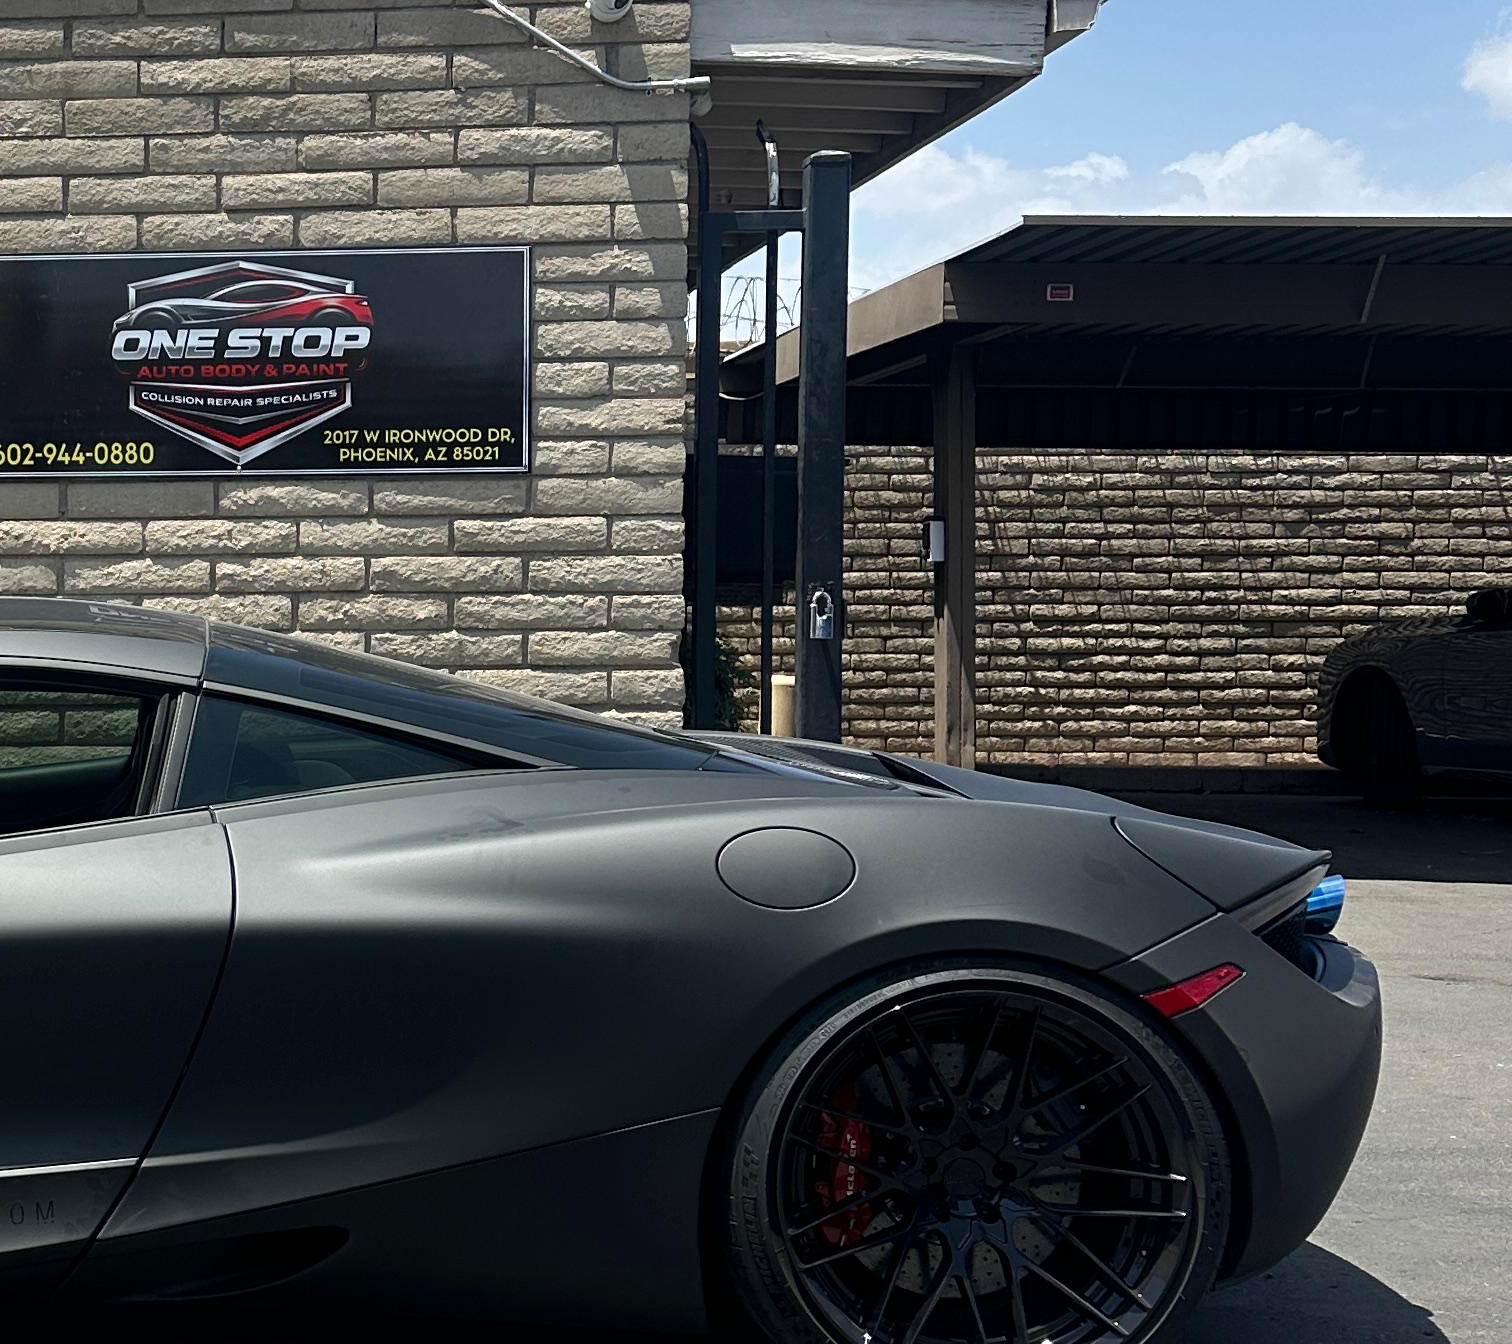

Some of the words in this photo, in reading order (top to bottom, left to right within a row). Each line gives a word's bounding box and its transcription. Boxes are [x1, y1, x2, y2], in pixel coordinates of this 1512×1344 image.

[111, 327, 220, 361] ONE
[224, 326, 371, 359] STOP
[137, 364, 195, 379] AUTO
[201, 363, 260, 378] BODY
[264, 363, 279, 377] &
[282, 362, 349, 376] PAINT
[141, 391, 204, 406] COLLISION
[207, 397, 253, 407] REPAIR
[256, 388, 338, 406] SPECIALISTS
[323, 429, 359, 444] 2017
[364, 429, 380, 443] W
[385, 428, 482, 444] IRONWOOD
[488, 428, 516, 444] DR,
[339, 447, 419, 464] PHOENIX,
[424, 447, 448, 461] AZ
[452, 446, 500, 461] 85021
